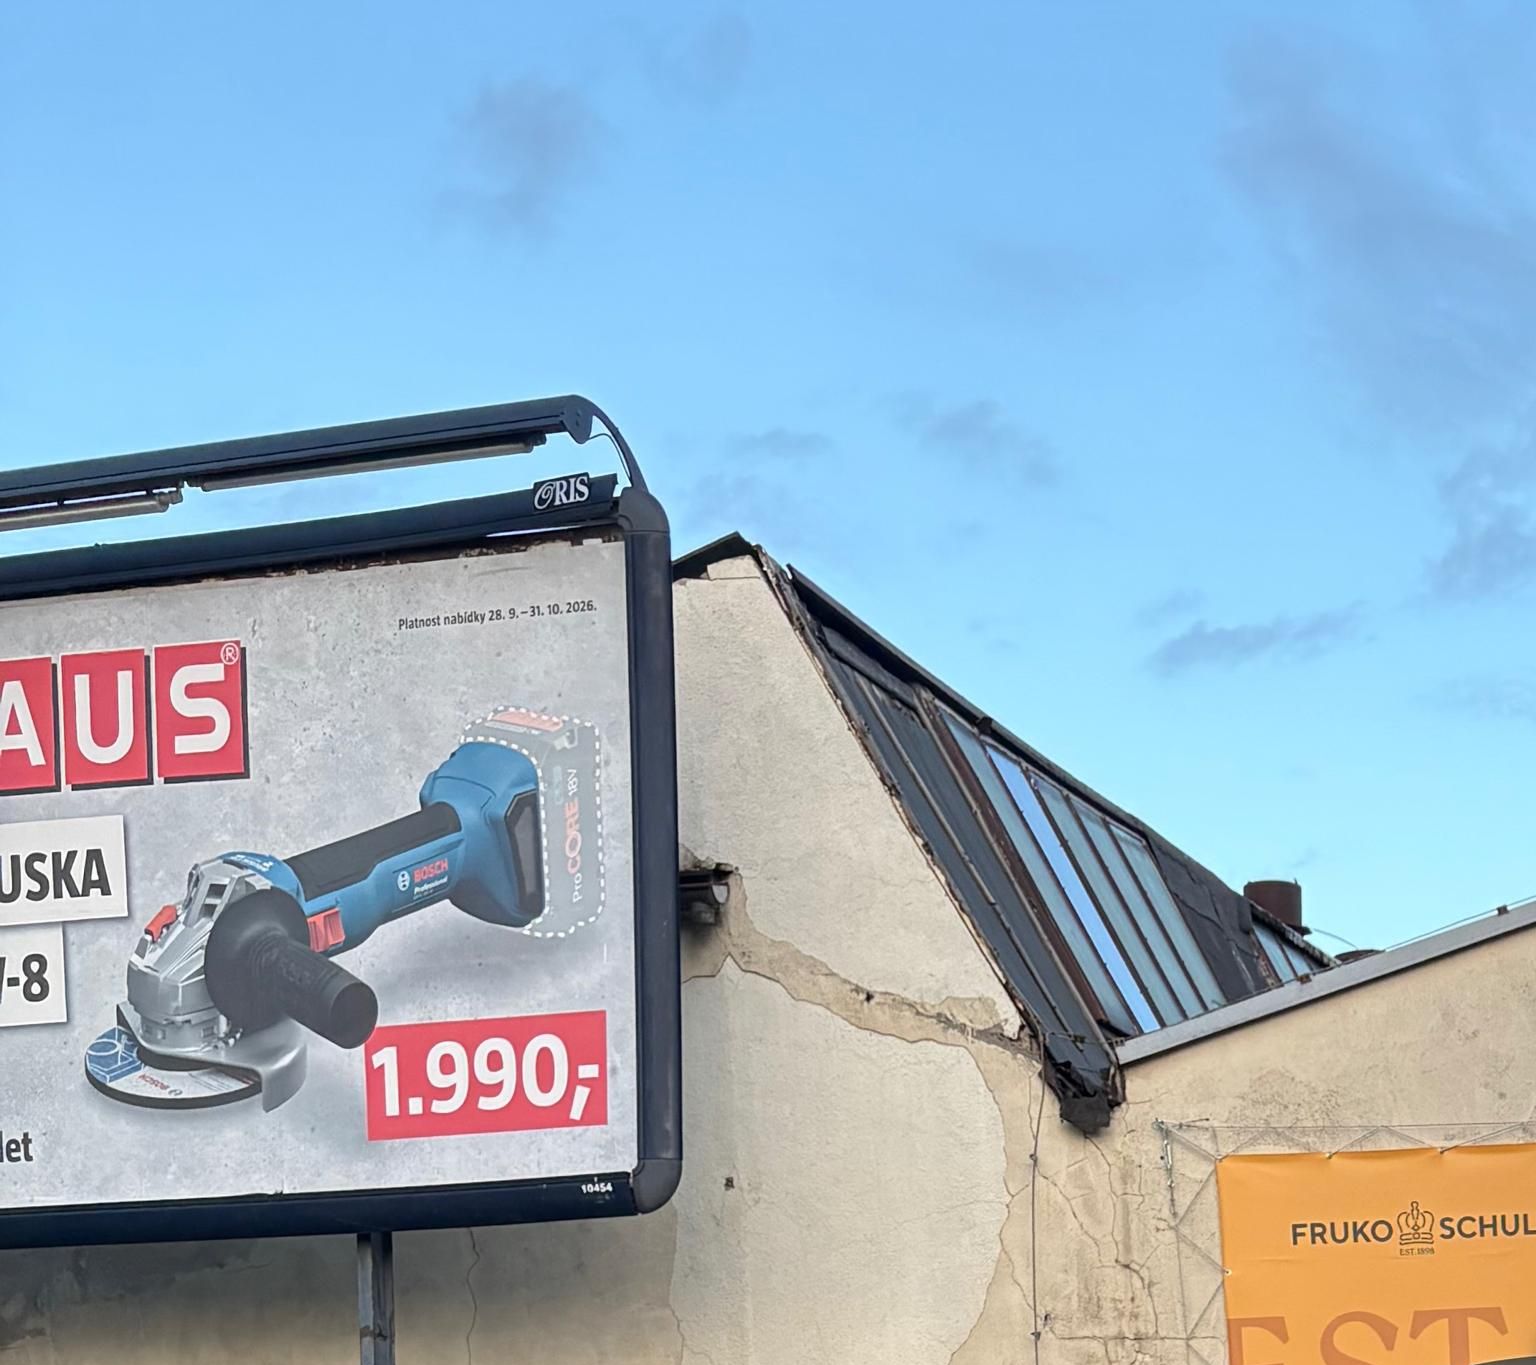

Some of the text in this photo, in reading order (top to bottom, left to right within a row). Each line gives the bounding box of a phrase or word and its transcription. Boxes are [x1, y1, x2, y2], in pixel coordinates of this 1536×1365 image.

[534, 476, 589, 510] ORIS
[398, 614, 441, 630] Platnost
[444, 610, 486, 625] nabídky
[488, 610, 505, 621] 28.
[547, 603, 563, 615] 10.
[566, 600, 597, 614] 2026.
[413, 858, 448, 883] BOSCH
[0, 953, 49, 1002] -8
[371, 1033, 599, 1121] 1.990,-
[581, 1182, 613, 1194] 10454
[1292, 1219, 1393, 1245] FRUKO
